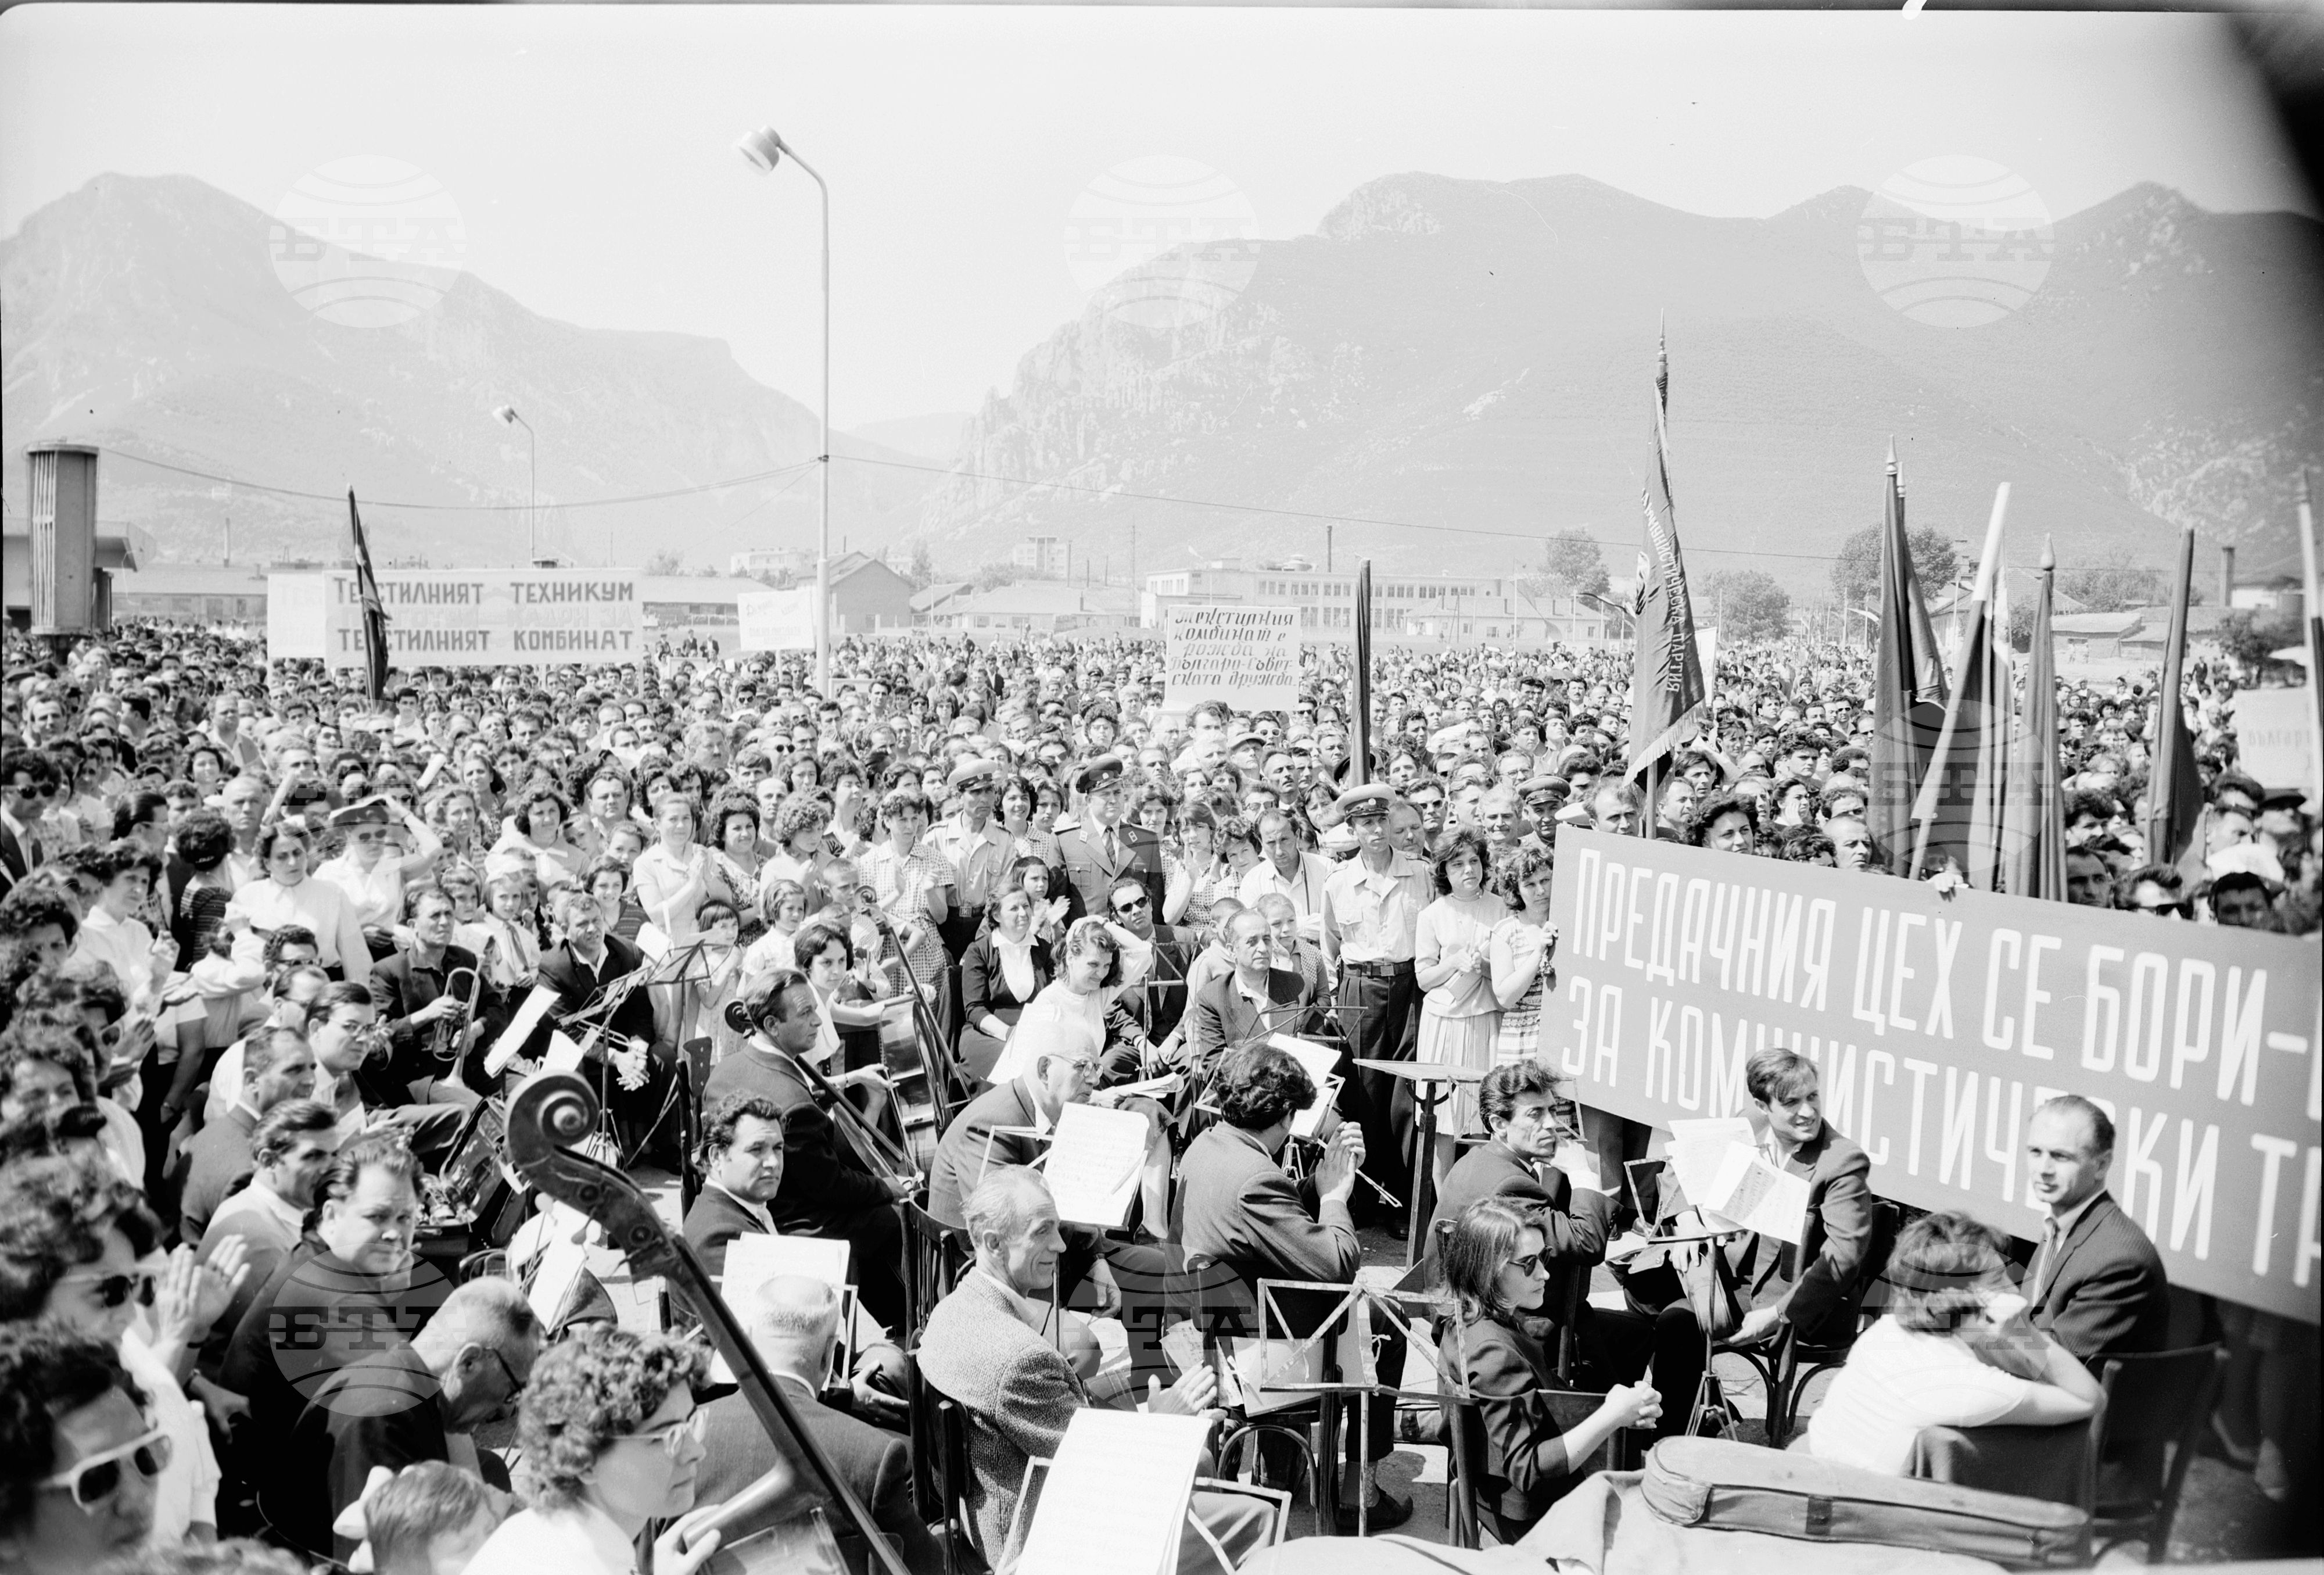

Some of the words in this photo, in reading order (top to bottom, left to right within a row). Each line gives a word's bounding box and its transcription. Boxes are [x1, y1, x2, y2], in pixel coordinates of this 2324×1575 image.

[333, 577, 483, 604] ТЕСТИЛНИЯТ
[510, 582, 633, 603] ТЕХНИКУМ
[338, 629, 490, 652] ТЕТИЛНИЯТ
[514, 630, 633, 651] КОМБИНАТ
[1183, 641, 1253, 658] рожба
[1265, 646, 1287, 657] на
[1278, 632, 1286, 642] е
[1666, 633, 1685, 693] ПАРТИЯ
[1572, 848, 1837, 1012] ПРЕДАЧНИЯ
[1852, 906, 1963, 1040] ЦЕХ
[1982, 928, 2062, 1060] СЕ
[1561, 975, 1623, 1087] ЗА
[1645, 996, 2220, 1261] КОМИСТИЧКИ
